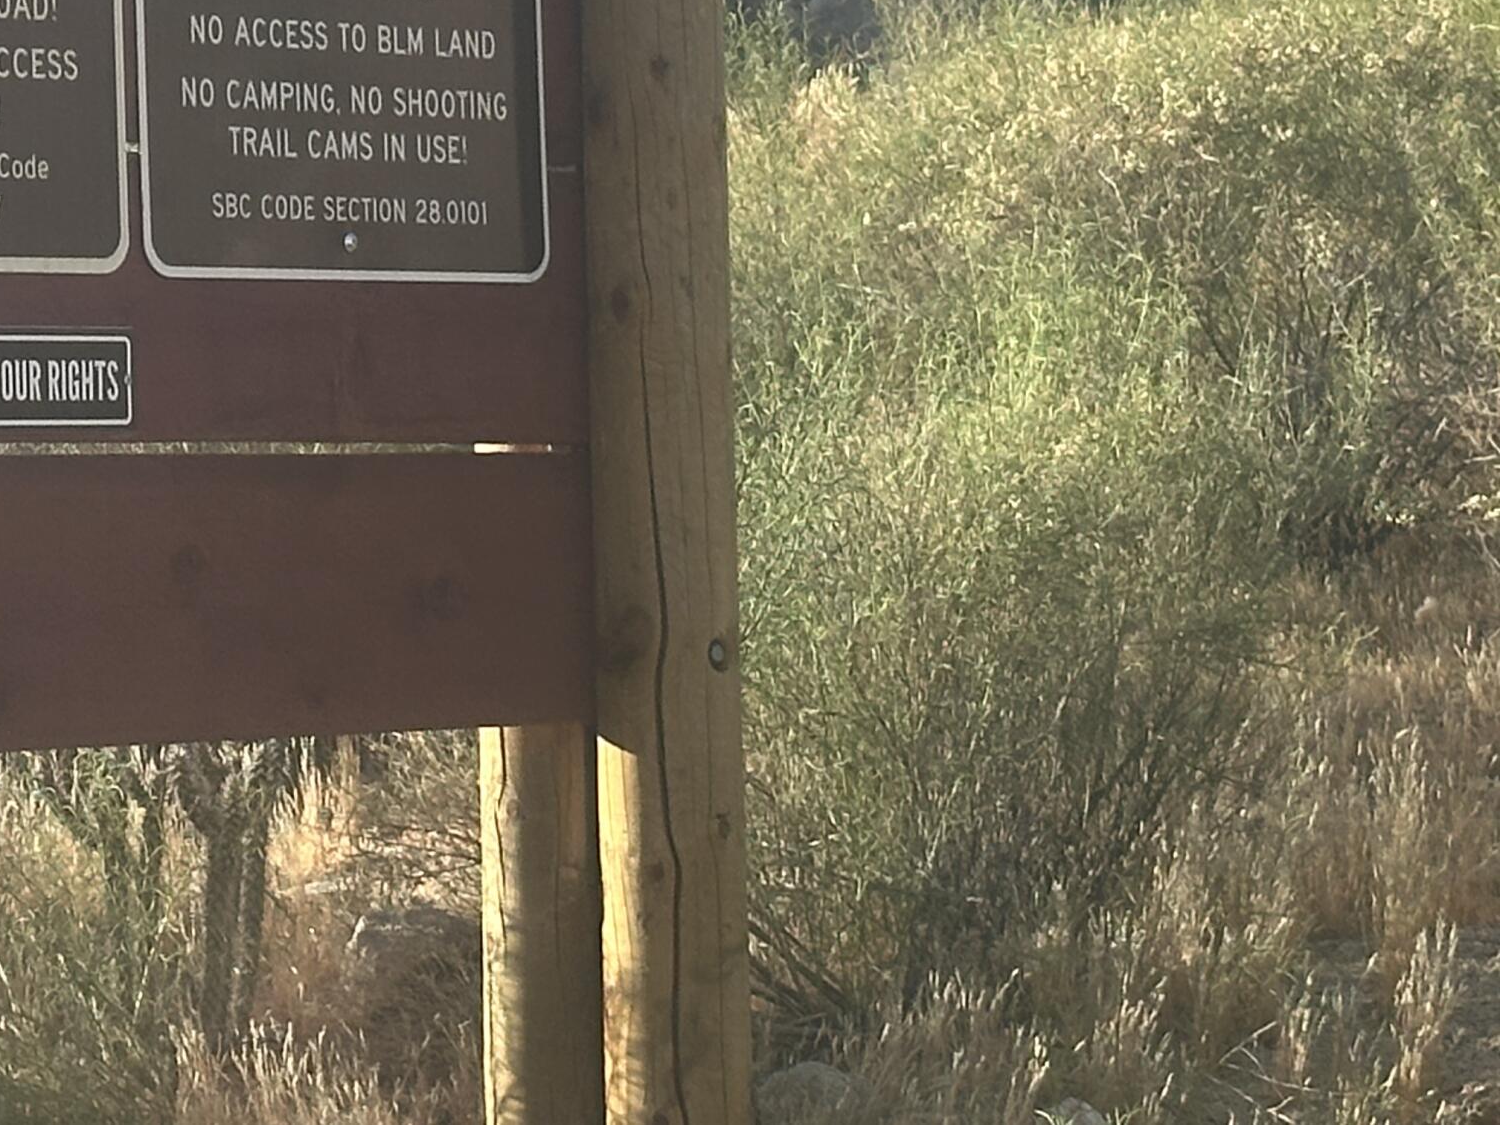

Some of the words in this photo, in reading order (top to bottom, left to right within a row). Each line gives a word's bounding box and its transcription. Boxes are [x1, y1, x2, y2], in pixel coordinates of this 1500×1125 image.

[190, 15, 223, 44] NO
[235, 16, 328, 51] ACCESS
[338, 23, 366, 52] TO
[378, 24, 424, 55] BLM
[435, 28, 495, 59] LAND
[181, 77, 215, 107] NO
[226, 79, 340, 114] CAMPING,
[350, 86, 382, 114] NO
[393, 88, 508, 121] SHOOTING
[228, 126, 297, 158] TRAIL
[308, 130, 373, 160] CAMS
[383, 133, 406, 161] IN
[417, 136, 467, 164] USE!
[212, 194, 251, 219] SBC
[261, 195, 315, 221] CODE
[324, 197, 406, 223] SECTION
[416, 199, 488, 225] 28.0101
[1, 360, 41, 402] OUR
[48, 360, 119, 402] RIGHTS
